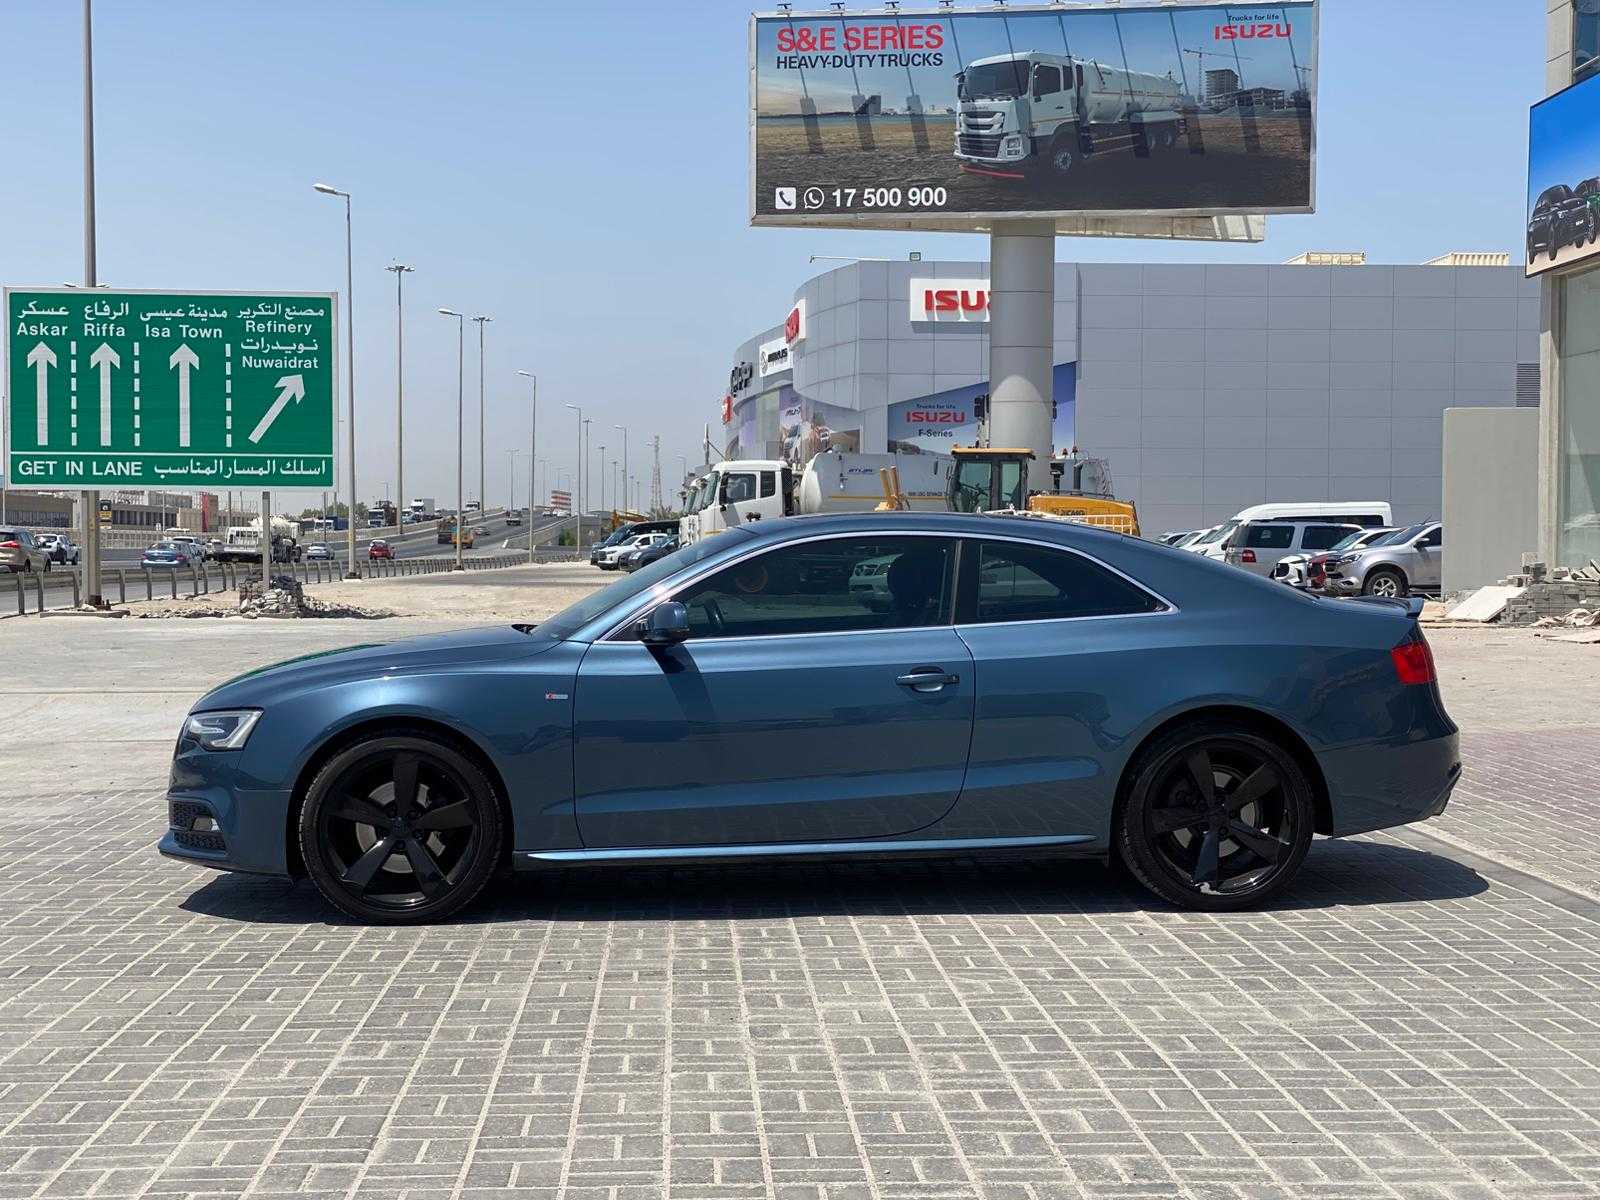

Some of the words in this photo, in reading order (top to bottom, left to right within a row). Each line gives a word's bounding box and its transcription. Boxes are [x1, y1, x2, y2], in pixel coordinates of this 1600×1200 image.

[777, 27, 836, 52] S&E
[843, 24, 944, 51] SERIES
[1215, 23, 1292, 40] ISUZU
[777, 54, 879, 69] HEAVY-DUTY
[878, 52, 943, 67] TRUCKS
[832, 188, 857, 207] 17
[863, 187, 902, 207] 500
[908, 187, 947, 206] 900
[925, 289, 991, 311] ISU
[17, 300, 69, 319] عسكر
[84, 300, 129, 321] الرفاع
[139, 308, 185, 322] عيسى
[188, 303, 228, 322] مدينة
[236, 302, 282, 319] التكرير
[284, 305, 325, 320] مصنع
[16, 322, 68, 336] Askar
[84, 323, 126, 337] Riffa
[145, 324, 171, 338] Isa
[178, 324, 223, 338] Town
[245, 320, 313, 336] Refinery
[241, 355, 319, 369] Nuwaidrat
[906, 411, 965, 423] ISUZU
[918, 429, 953, 438] F-Series
[18, 460, 58, 476] GET
[65, 460, 84, 476] IN
[92, 461, 143, 476] LANE
[153, 457, 224, 479] المناسب
[223, 458, 277, 479] المسار
[279, 458, 326, 476] اسلك
